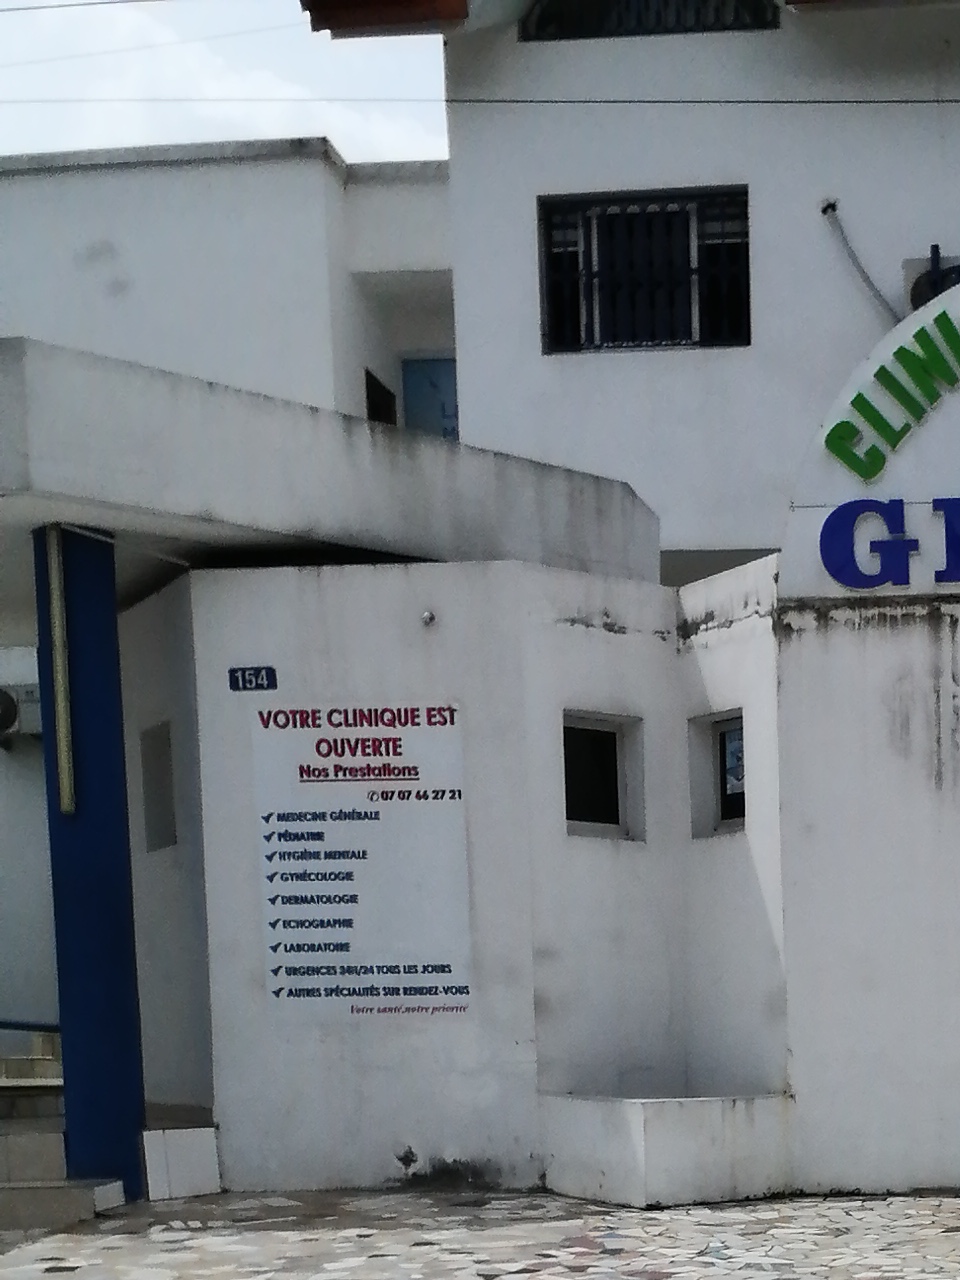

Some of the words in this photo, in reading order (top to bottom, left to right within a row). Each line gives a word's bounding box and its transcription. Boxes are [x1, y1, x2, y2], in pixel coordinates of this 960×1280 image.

[234, 669, 268, 689] 154
[258, 709, 322, 729] VOTRE
[326, 707, 421, 729] CLINIQUE
[426, 705, 458, 726] EST
[315, 737, 403, 758] OUVERTE
[299, 764, 329, 779] Nos
[333, 763, 420, 778] Prestations
[380, 790, 396, 801] 07
[397, 790, 412, 801] 07
[415, 790, 430, 801] 66
[432, 789, 446, 801] 27
[449, 789, 462, 800] 21
[324, 850, 368, 861] MENTALE
[280, 869, 354, 882] GYNÉCOLOGIE
[281, 894, 359, 905] DERMATOLOGIE
[282, 918, 354, 929] ECHOGRAPHIE
[284, 942, 351, 953] LABORATOIRE
[284, 965, 337, 976] URGENCES
[375, 965, 401, 975] TOUS
[403, 964, 418, 974] LES
[420, 964, 452, 974] JOURS
[286, 987, 322, 998] AUTRES
[323, 984, 381, 997] SPÉCIALITÉS
[382, 986, 400, 996] SUR
[402, 985, 470, 997] RENDEZ-VOUS
